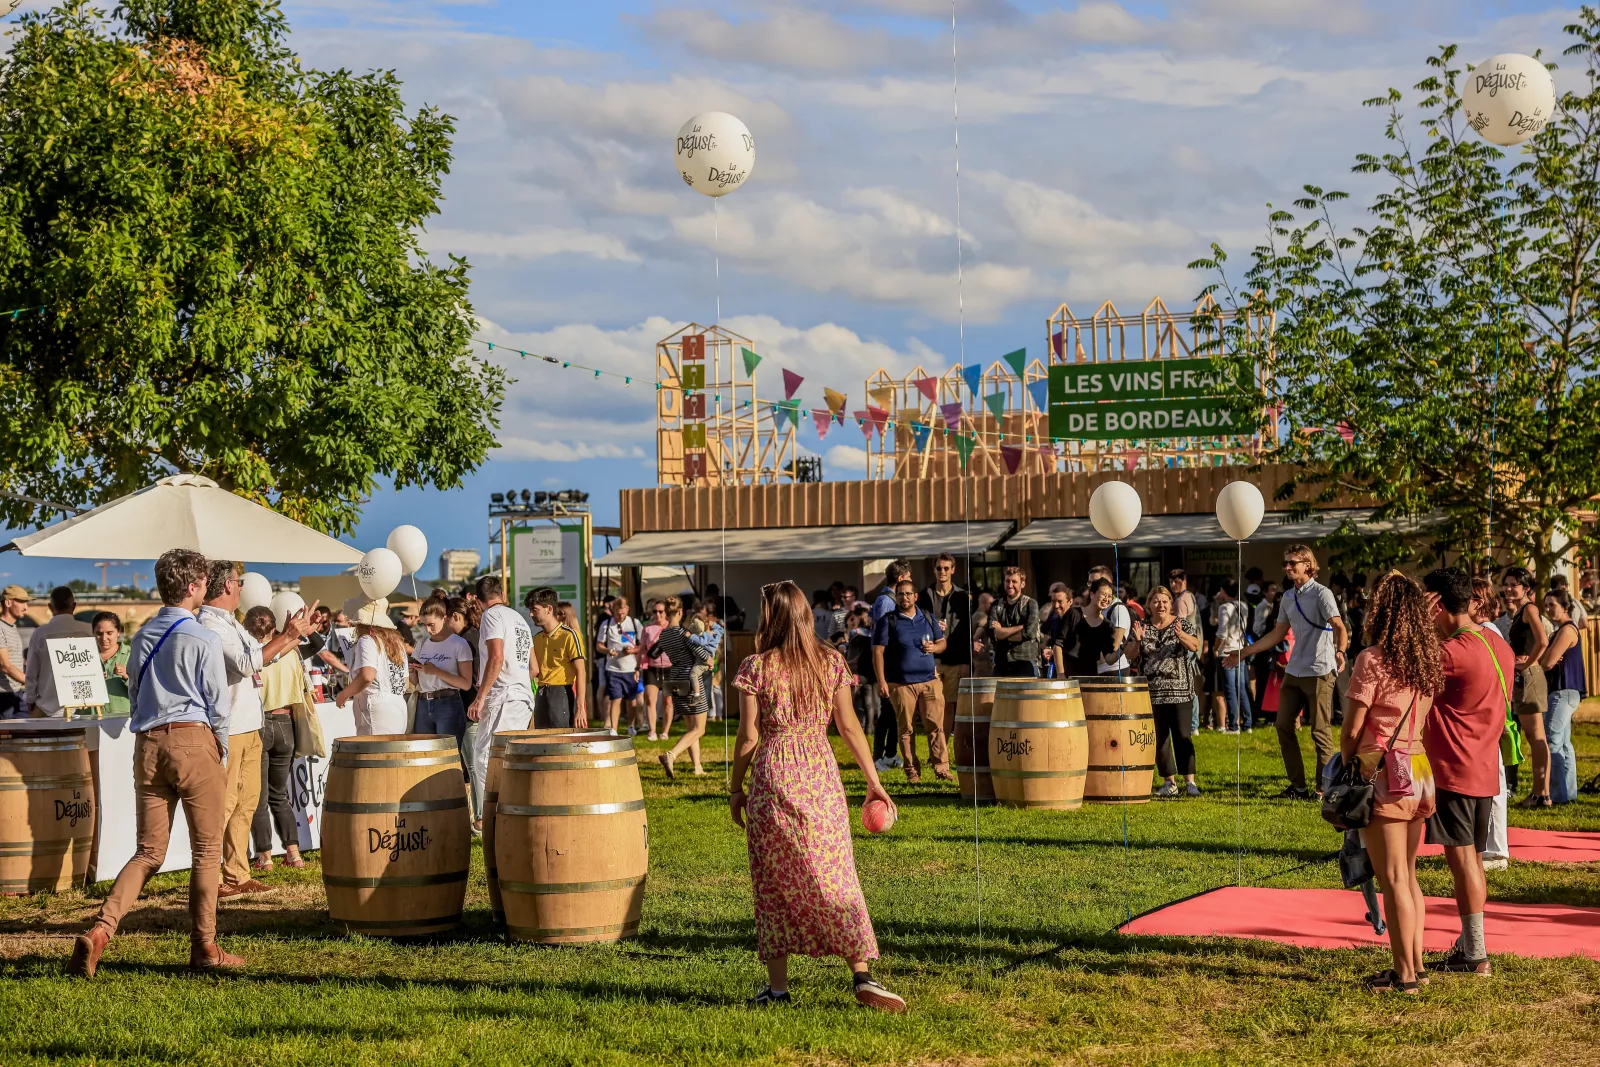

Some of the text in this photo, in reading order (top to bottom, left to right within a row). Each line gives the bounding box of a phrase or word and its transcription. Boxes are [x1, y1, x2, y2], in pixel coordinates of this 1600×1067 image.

[1496, 63, 1506, 71] La
[693, 124, 701, 132] La
[729, 162, 737, 170] La
[1064, 374, 1103, 394] LES
[1109, 371, 1163, 392] VINS
[1069, 408, 1234, 432] DE BORDEAUX
[69, 643, 77, 651] La
[1142, 722, 1148, 730] La
[1010, 731, 1016, 739] La
[73, 789, 81, 799] La
[395, 816, 406, 828] La
[368, 826, 433, 862] Dégust.fr
